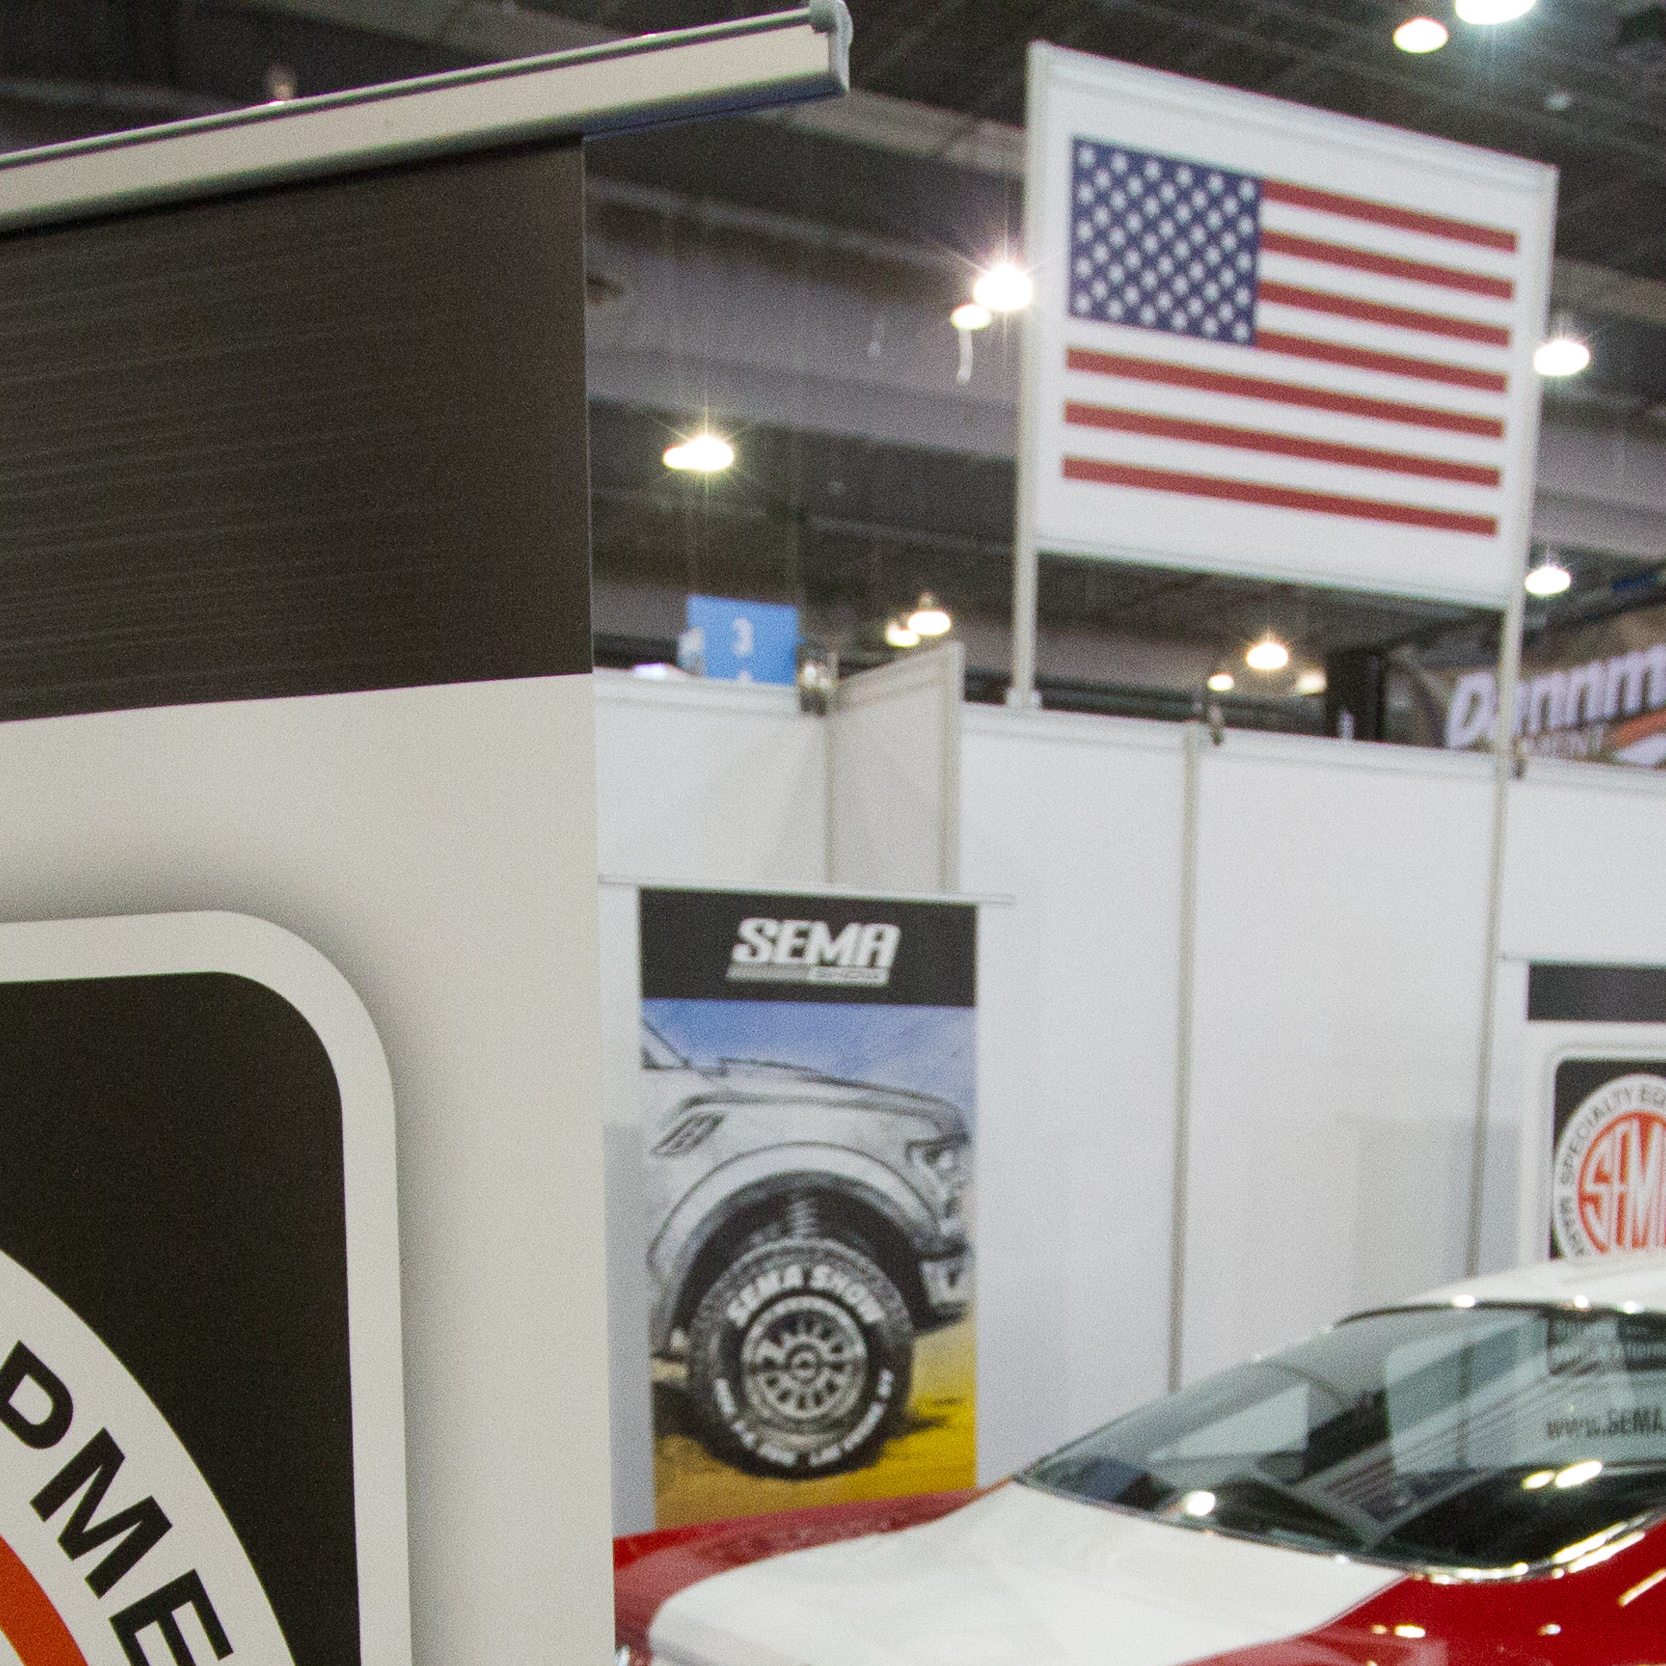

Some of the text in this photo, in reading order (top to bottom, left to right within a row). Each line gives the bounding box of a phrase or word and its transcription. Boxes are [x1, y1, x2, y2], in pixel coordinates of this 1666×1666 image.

[731, 916, 901, 967] SEMA
[726, 1263, 884, 1329] SEMA SHOW
